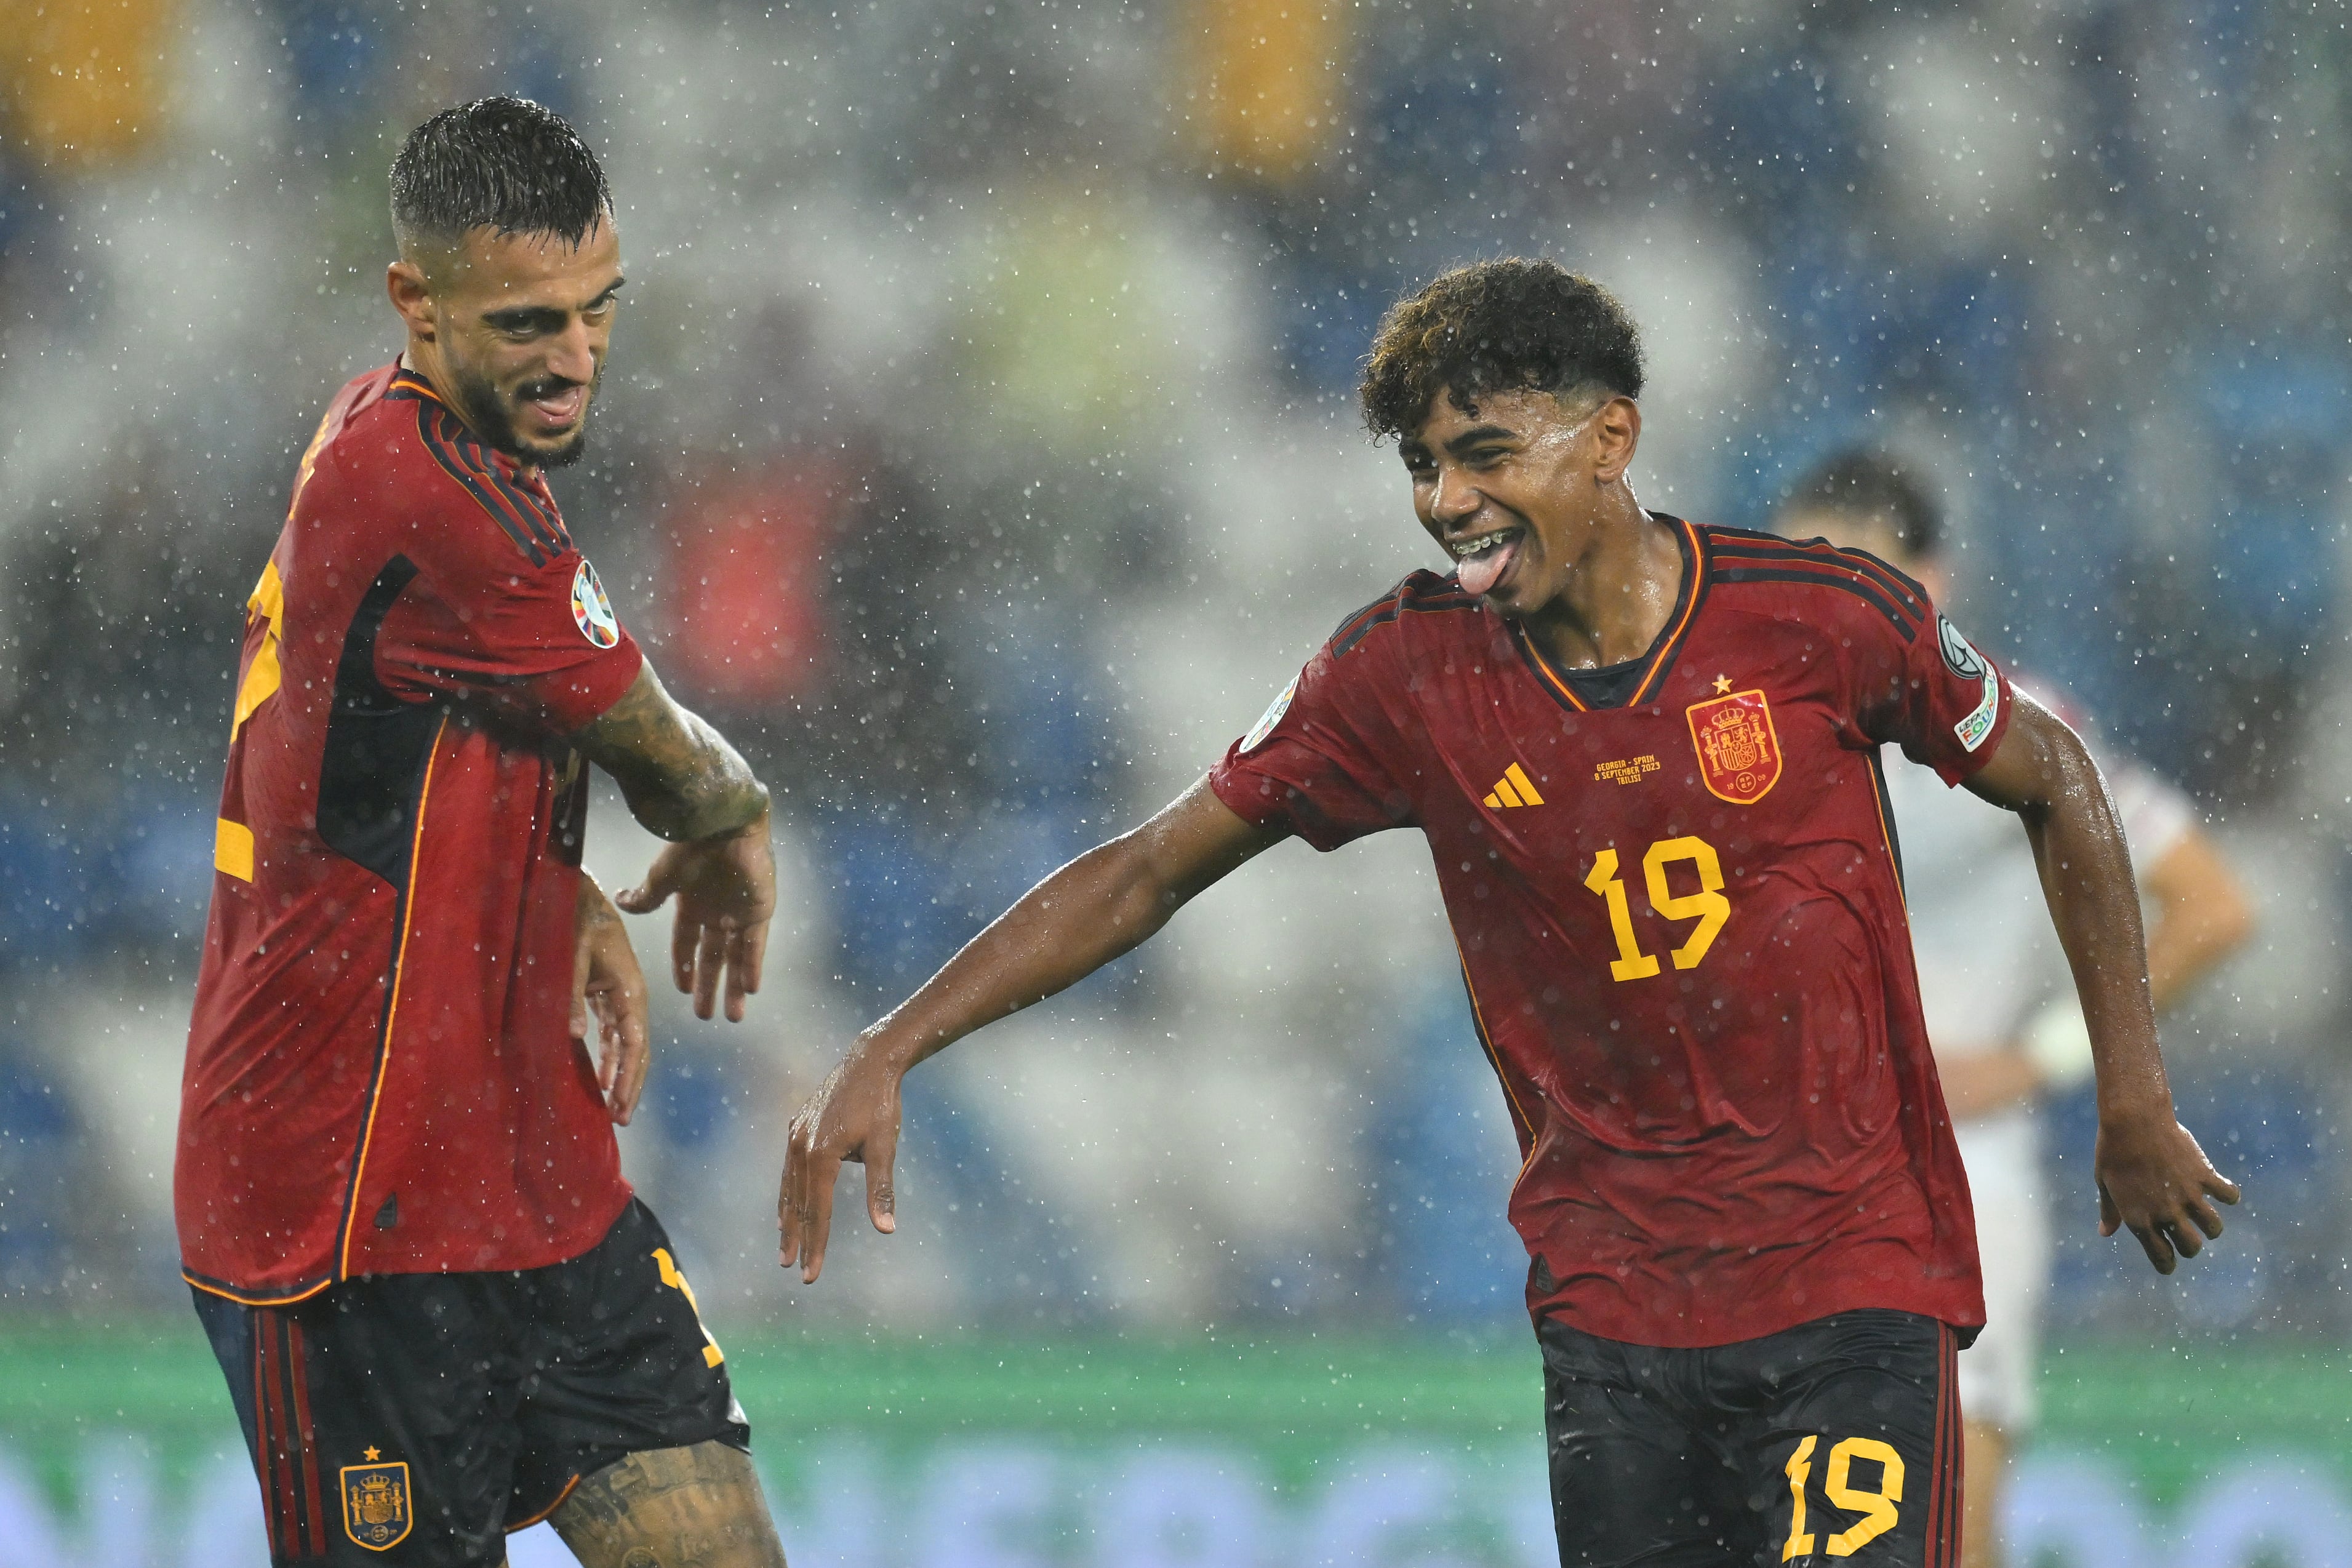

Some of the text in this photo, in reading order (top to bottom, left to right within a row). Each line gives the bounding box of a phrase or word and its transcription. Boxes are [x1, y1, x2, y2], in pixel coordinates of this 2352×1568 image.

[1959, 712, 1981, 734] UEFA
[1594, 761, 1660, 781] 8 SEPTEMBER 2023
[1596, 759, 1626, 772] GEORGIA
[1633, 754, 1655, 766] SPAIN
[1616, 774, 1642, 785] TBILISI
[1583, 836, 1731, 982] 19
[1782, 1434, 1905, 1564] 19
